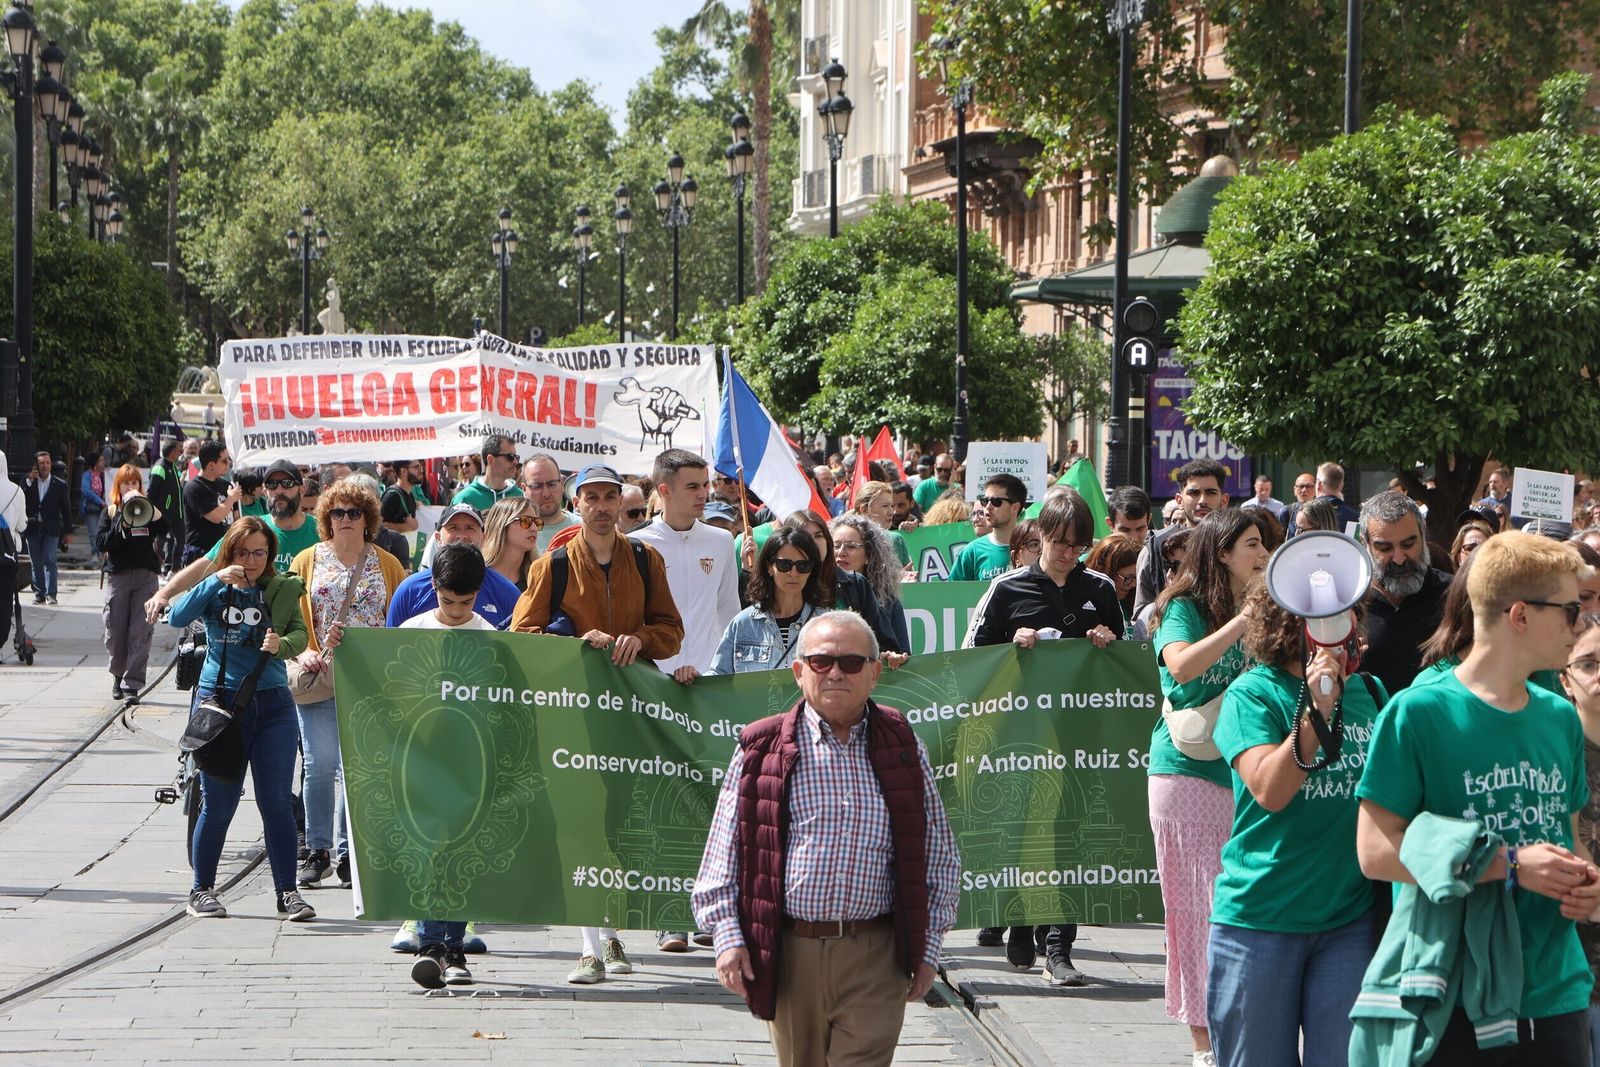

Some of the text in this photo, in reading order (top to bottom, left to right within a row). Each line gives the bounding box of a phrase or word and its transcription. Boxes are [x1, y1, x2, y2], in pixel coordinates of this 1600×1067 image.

[233, 344, 277, 363] PARA
[281, 340, 363, 361] DEFENDER
[368, 338, 402, 358] UNA
[408, 338, 472, 358] ESCUELA
[619, 347, 628, 367] Y
[635, 346, 701, 367] SEGURA
[1130, 343, 1147, 365] A
[239, 364, 598, 429] ¡HUELGA GENERAL!
[243, 426, 437, 451] IZQUIERDA REVOLUCIONARIA
[513, 429, 527, 445] de
[530, 432, 618, 456] Estudiantes
[441, 680, 1156, 742] Por un centro de trabajo dig adecuado a nuestras
[552, 748, 704, 783] Conservatorio
[1074, 747, 1121, 769] Ruiz
[1463, 767, 1528, 795] ESCUELA
[572, 864, 1160, 893] #SOSConse SevillaconlaDanz
